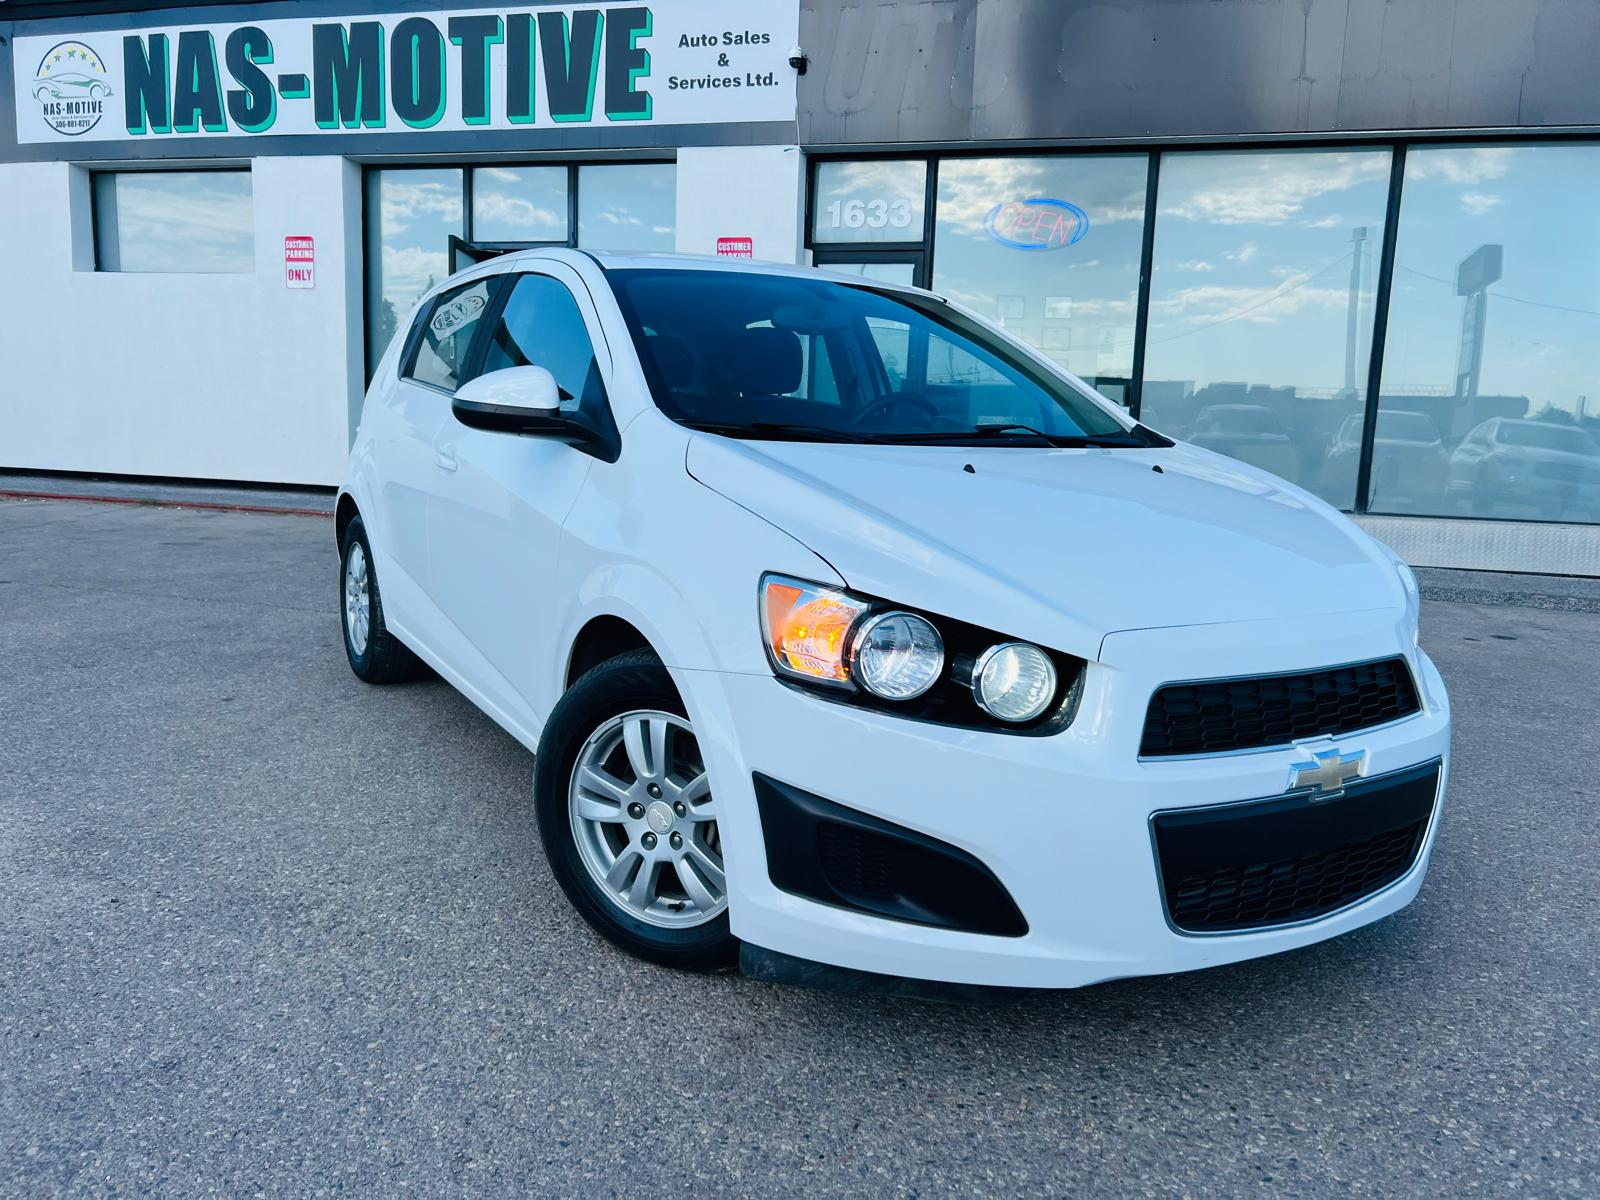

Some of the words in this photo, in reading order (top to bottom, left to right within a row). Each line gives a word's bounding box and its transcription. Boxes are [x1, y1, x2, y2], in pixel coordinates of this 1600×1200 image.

[678, 34, 718, 48] Auto
[722, 30, 771, 46] Sales
[717, 52, 730, 67] &
[123, 7, 653, 135] NAS-MOTIVE
[668, 74, 742, 90] Services
[746, 72, 779, 87] Ltd.
[43, 101, 102, 115] NAS-MOTIVE
[826, 200, 913, 229] 1633
[999, 202, 1075, 245] OPEN
[286, 249, 313, 259] PARKING
[718, 242, 752, 251] CUSTOMER
[288, 269, 312, 281] ONLY
